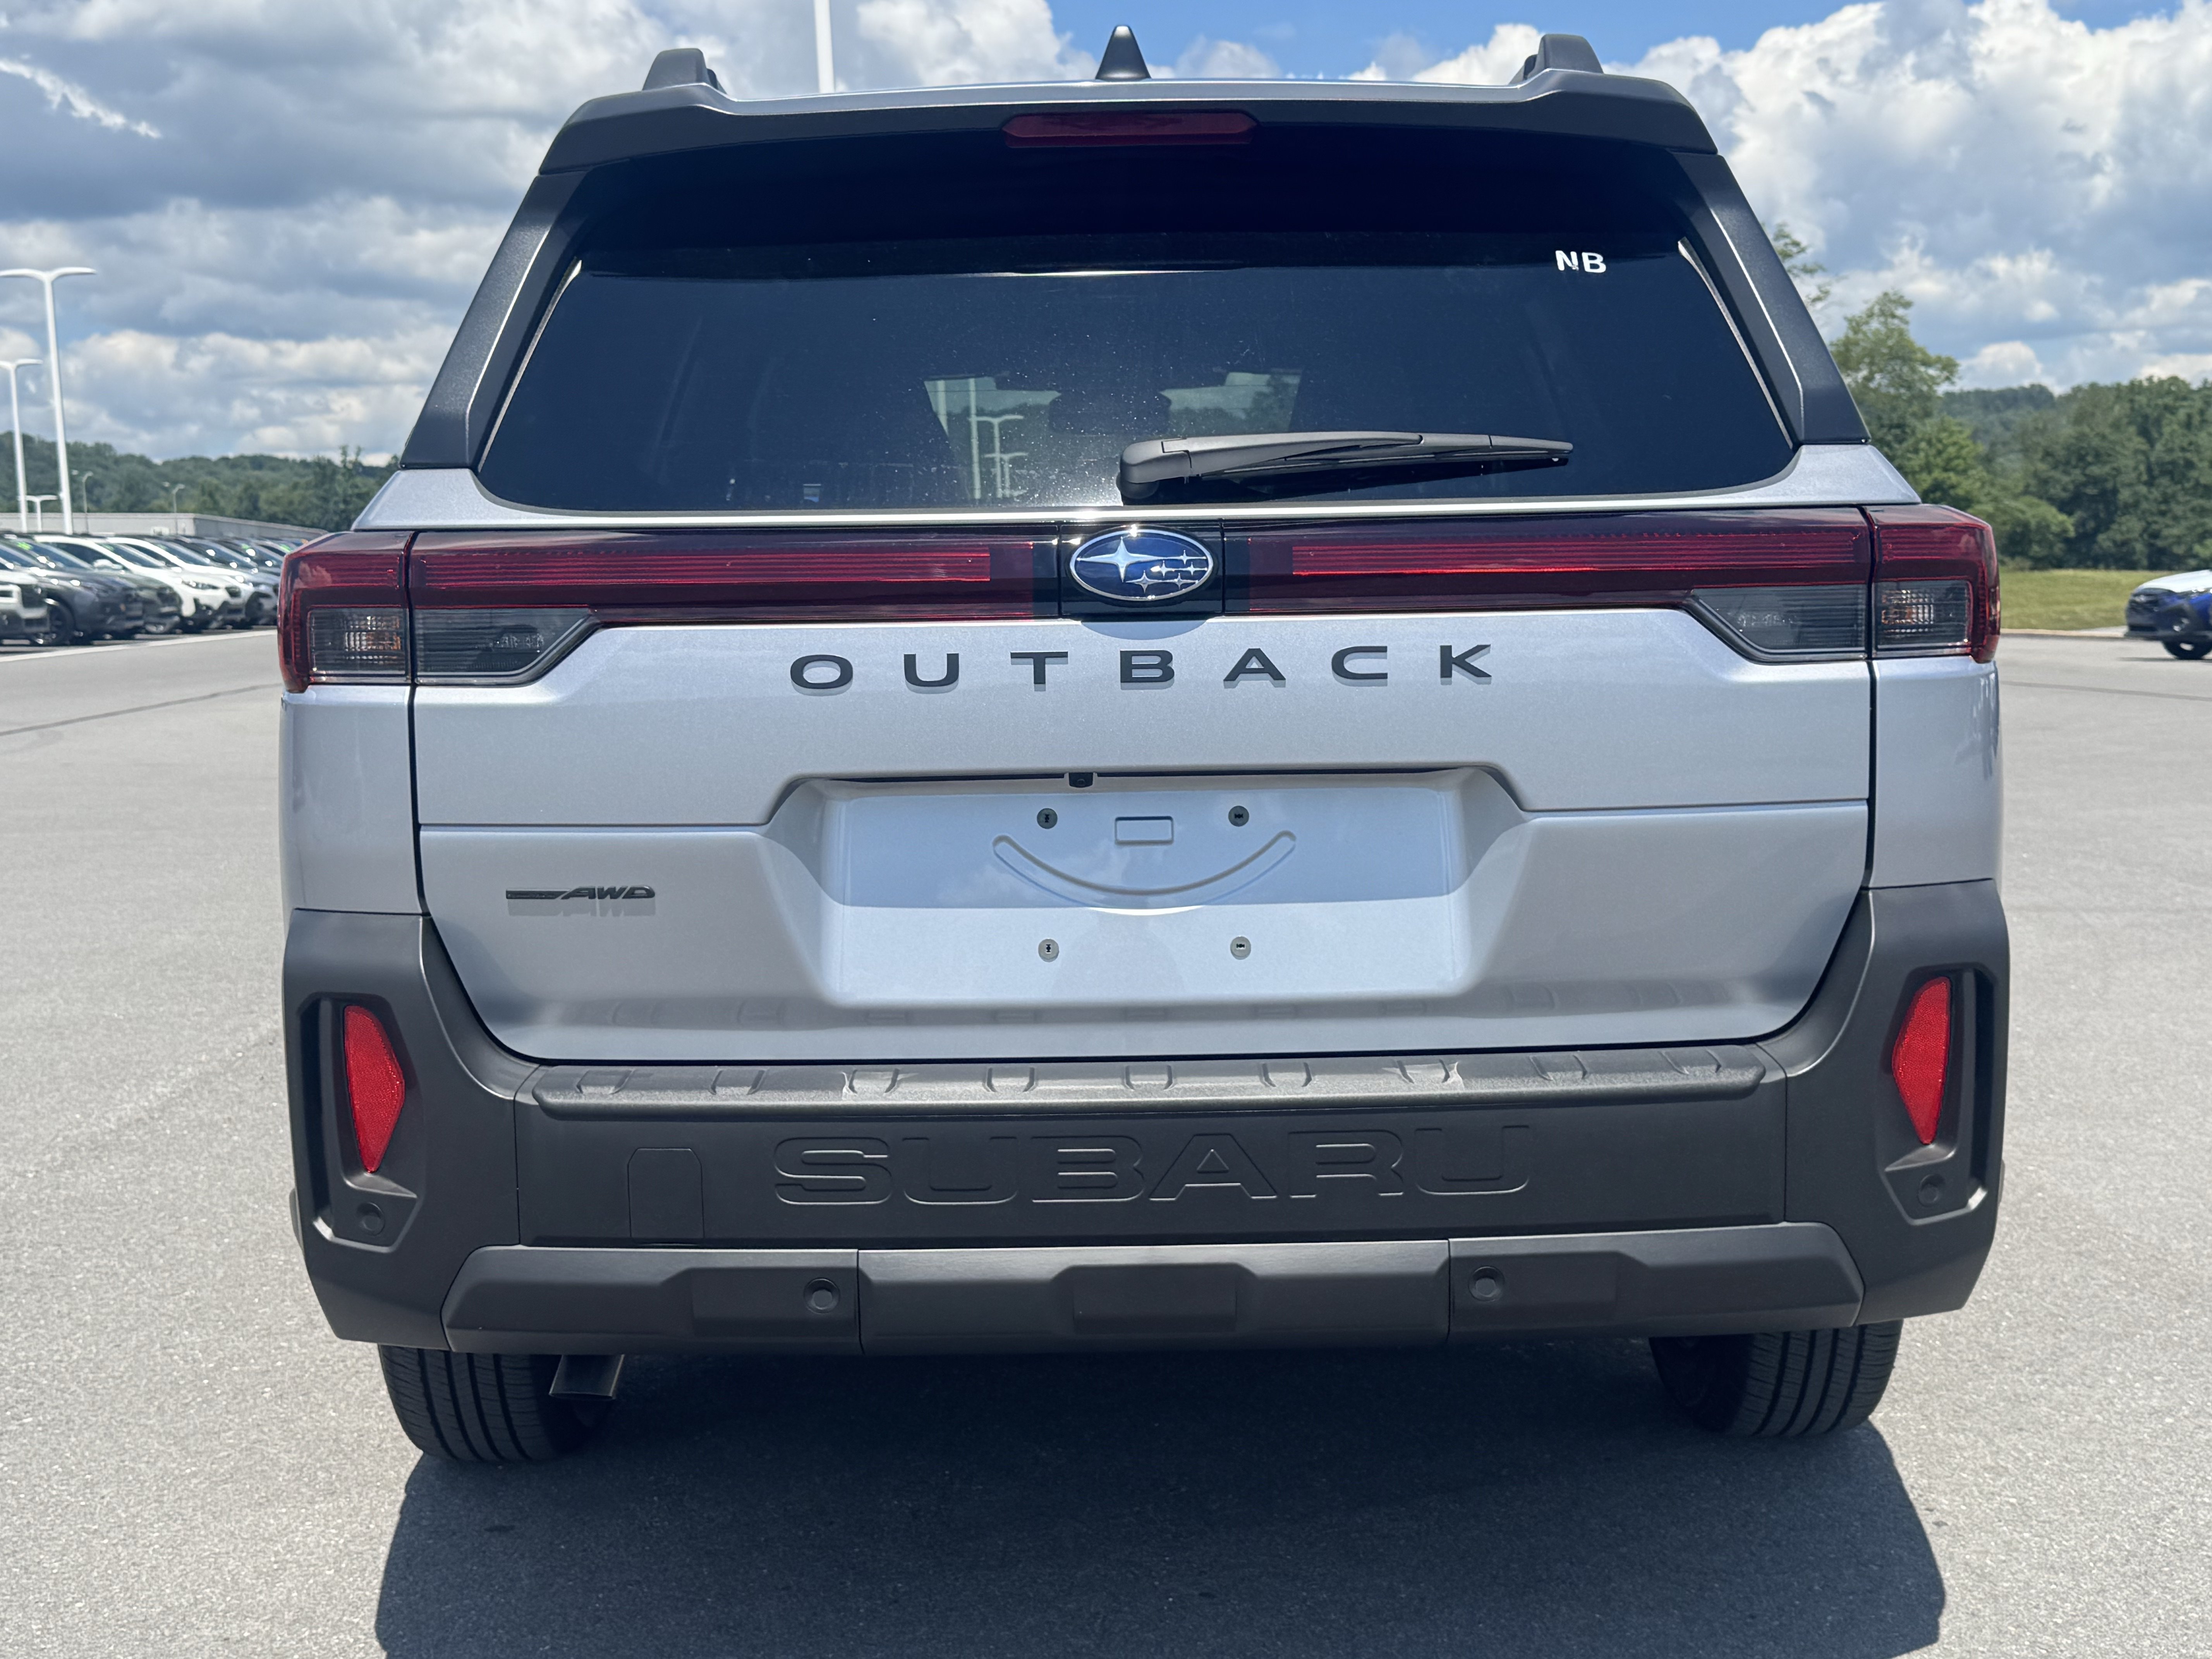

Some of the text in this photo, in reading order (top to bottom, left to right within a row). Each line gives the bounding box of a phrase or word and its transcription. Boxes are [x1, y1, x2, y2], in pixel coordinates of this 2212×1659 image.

[1555, 250, 1606, 273] NB
[790, 644, 1492, 689] OUTBACK
[561, 886, 656, 900] AWD
[774, 1125, 1529, 1204] SUBARU
